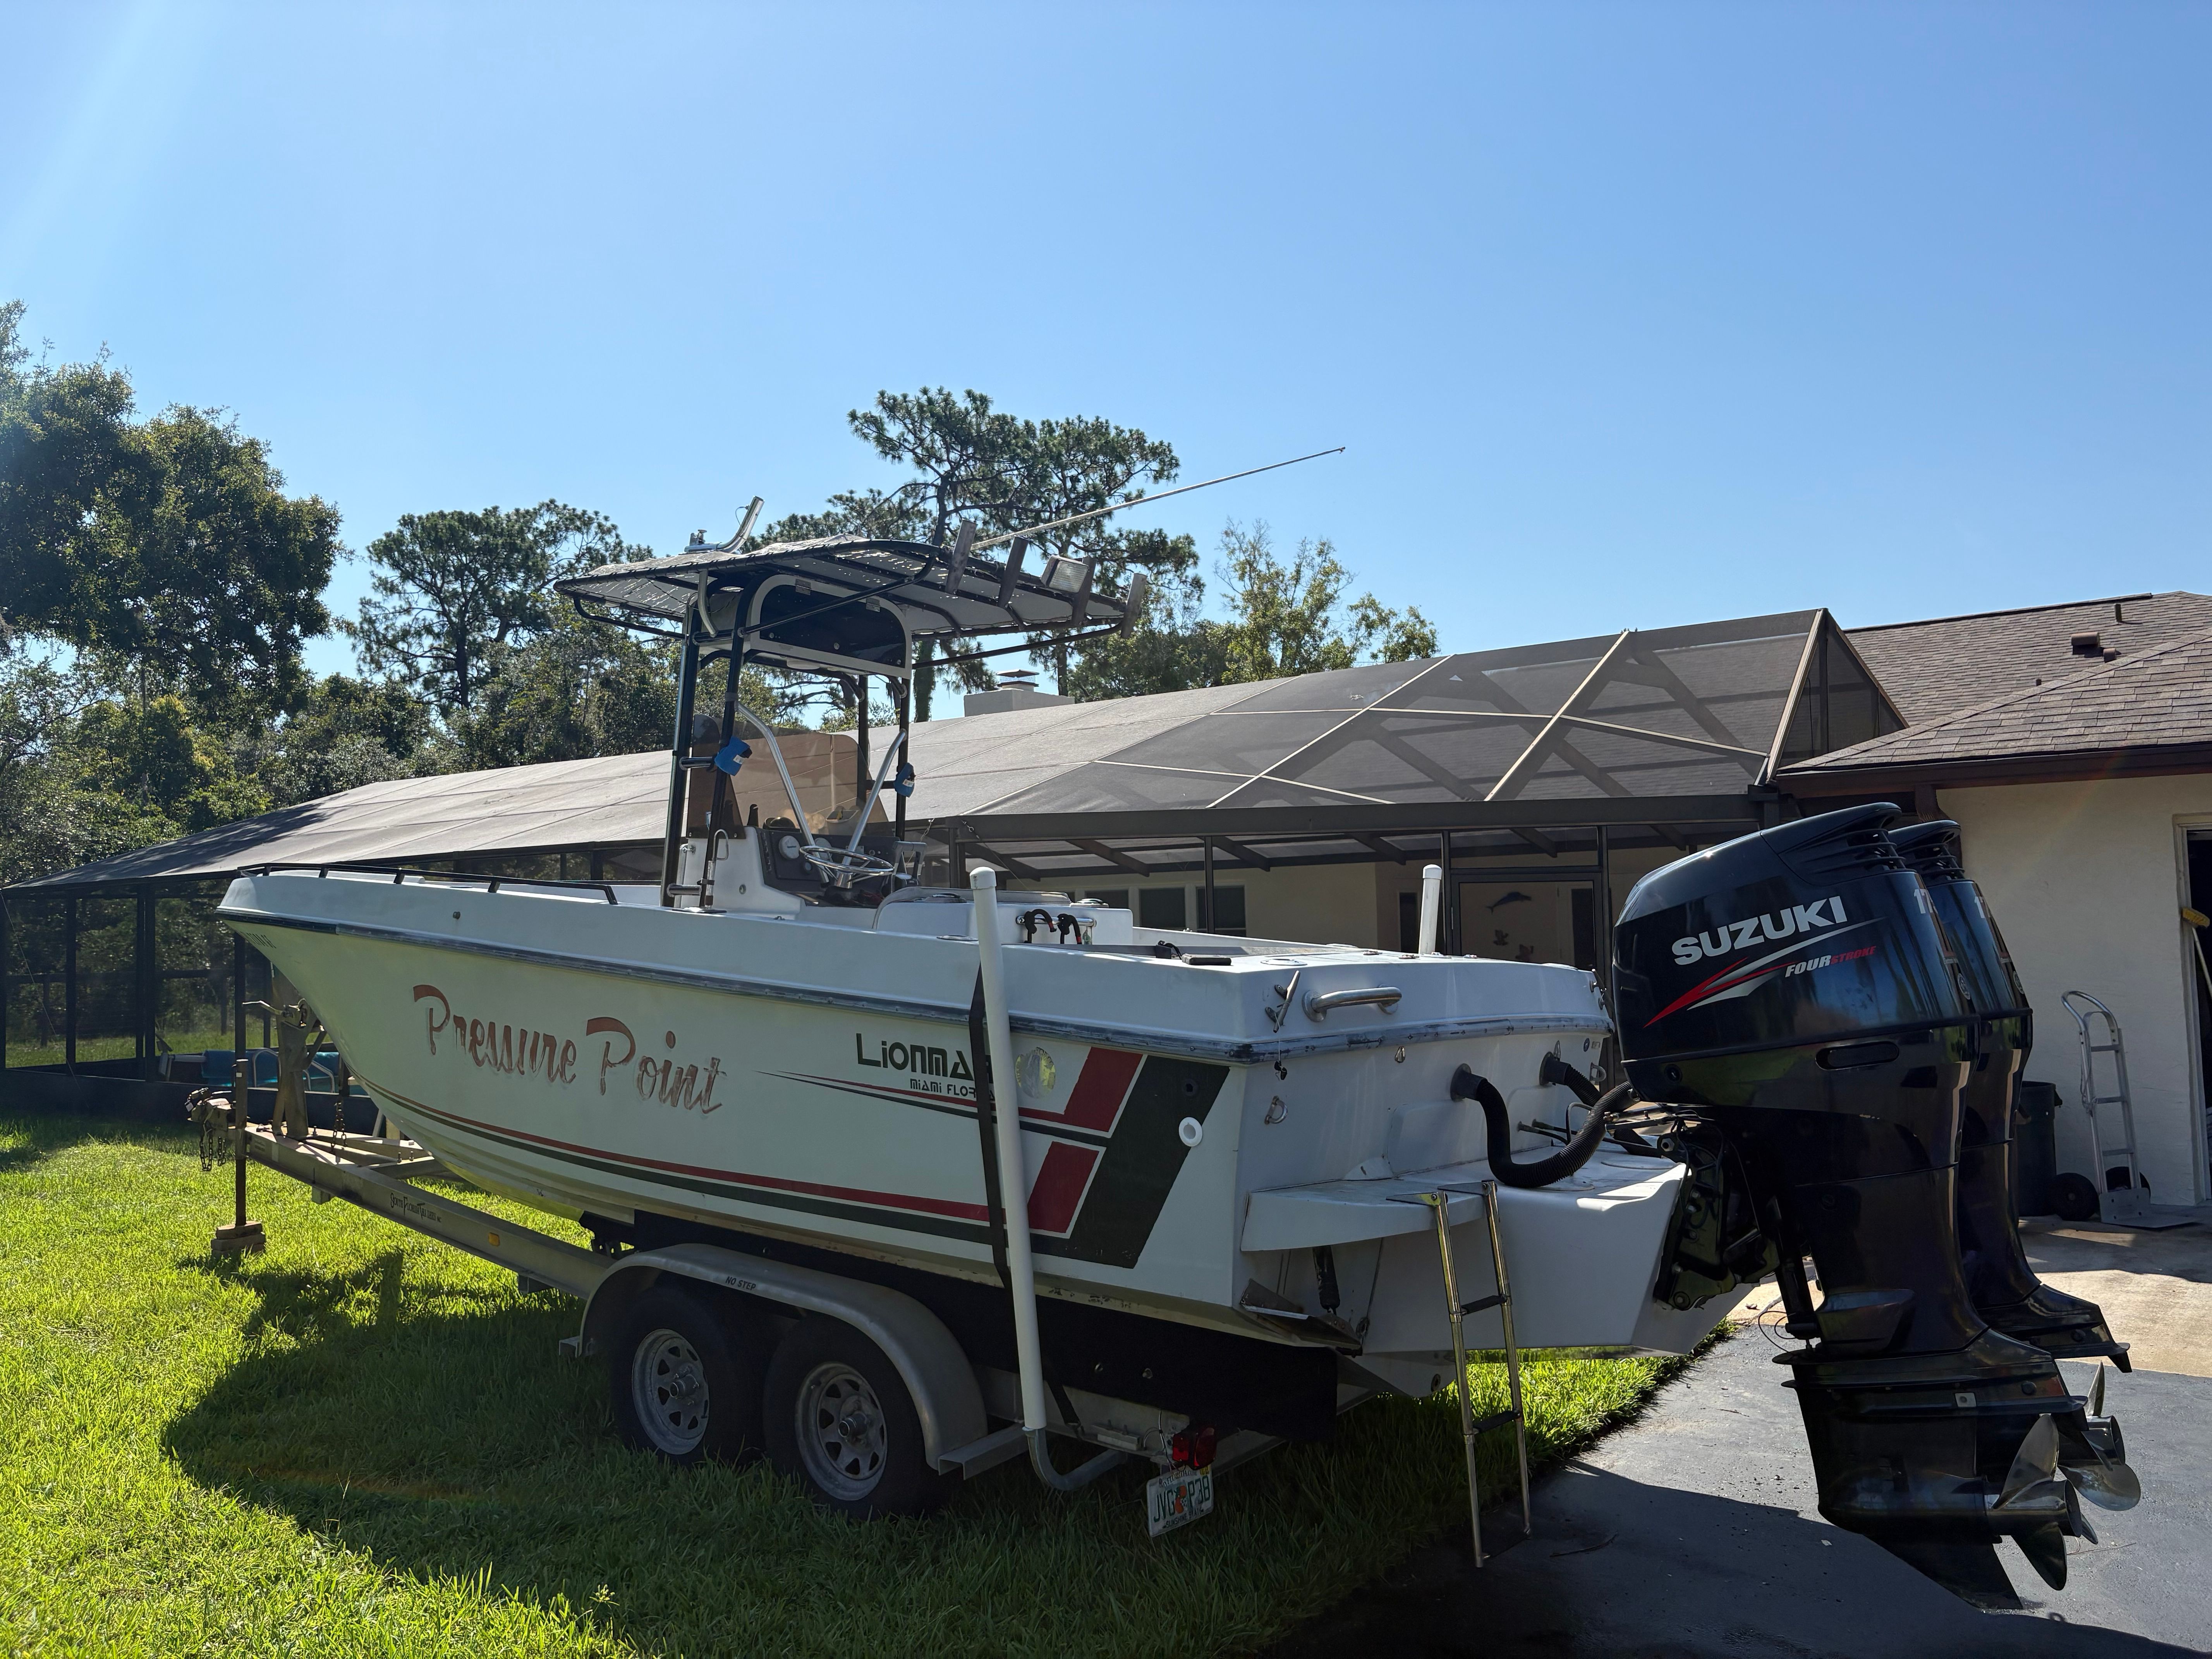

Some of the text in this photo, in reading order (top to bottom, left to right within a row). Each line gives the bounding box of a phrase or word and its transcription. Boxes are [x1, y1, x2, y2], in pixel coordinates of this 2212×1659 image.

[1671, 895, 1847, 965] SUZUKI
[412, 984, 727, 1114] Pressure Point
[725, 1276, 756, 1291] NO STEP
[1166, 1513, 1188, 1527] SUNSHINE
